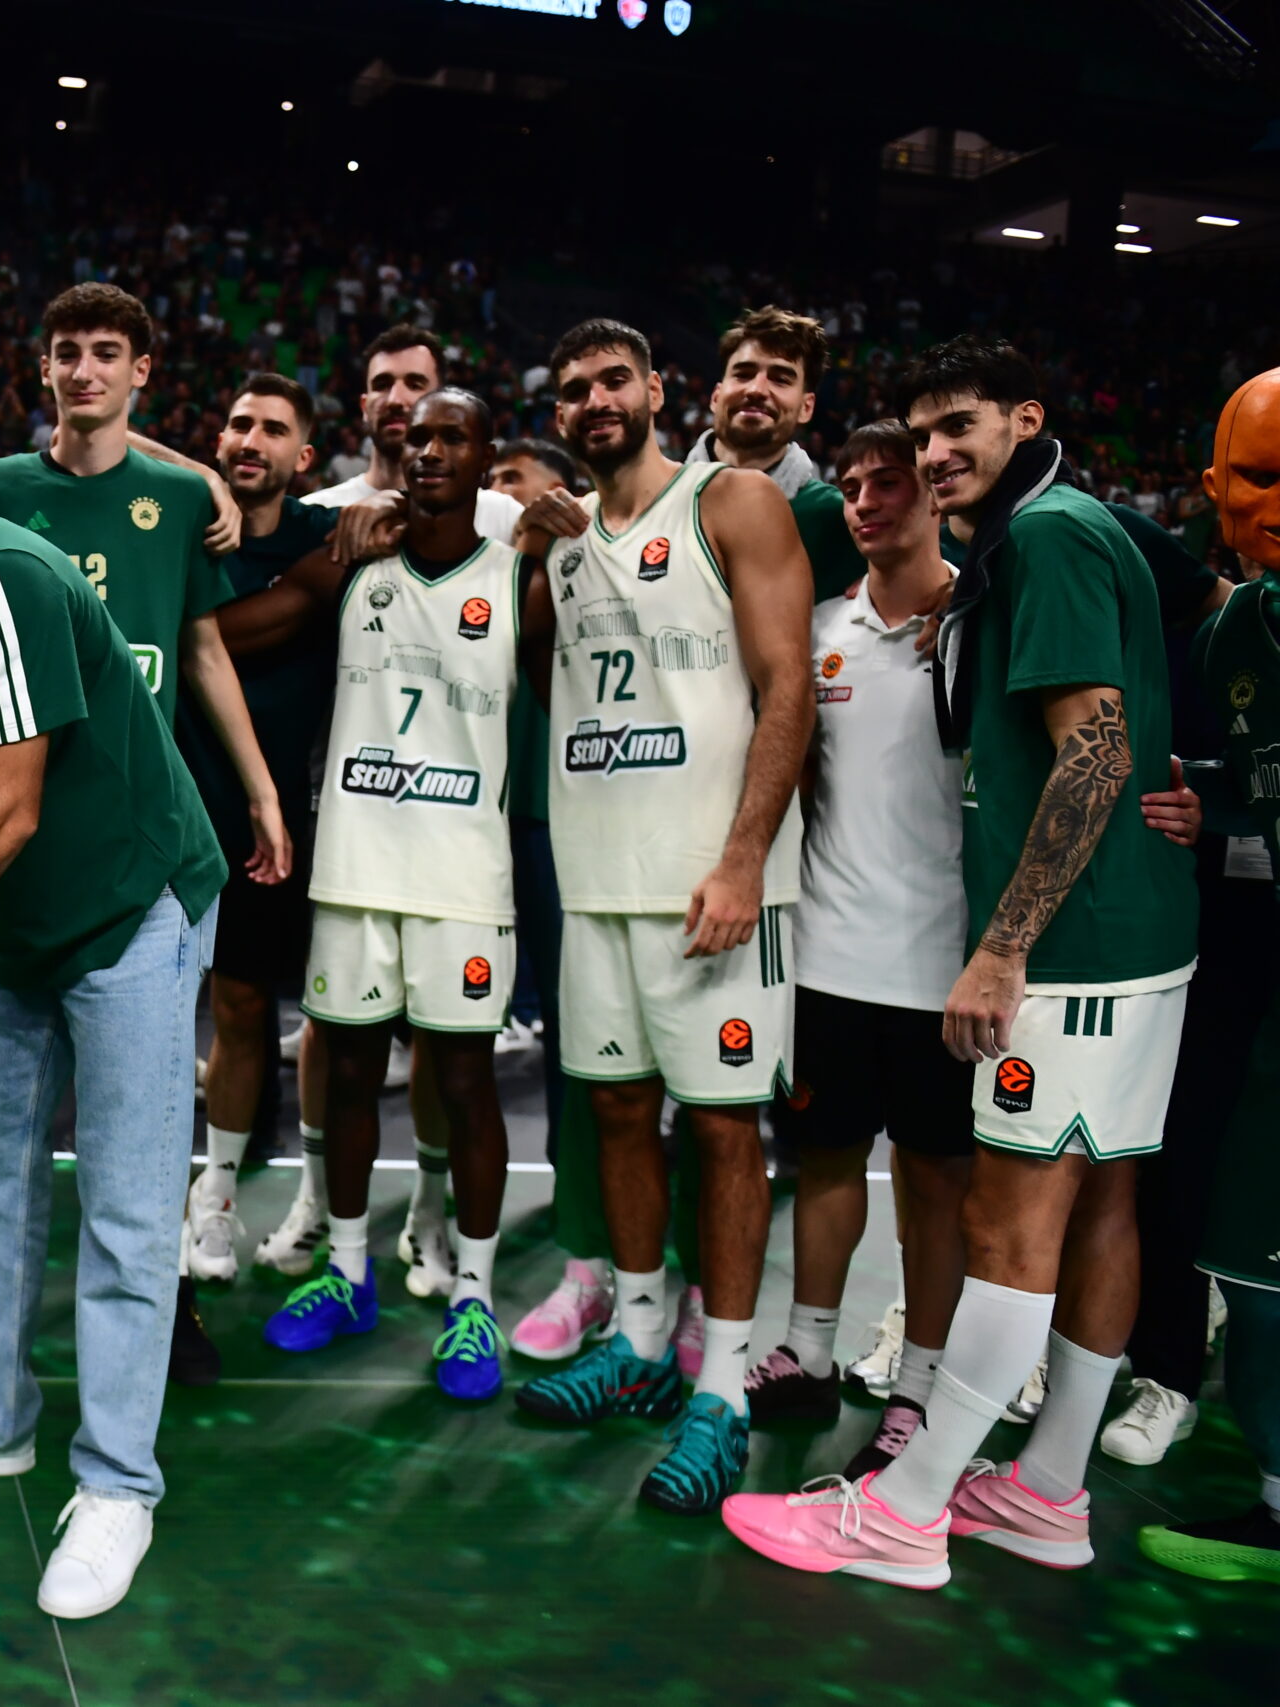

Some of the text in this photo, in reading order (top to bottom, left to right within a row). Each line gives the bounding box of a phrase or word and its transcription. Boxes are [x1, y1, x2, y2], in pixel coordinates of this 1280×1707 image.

[68, 553, 107, 600] 2
[591, 649, 636, 703] 72
[398, 687, 423, 735] 7
